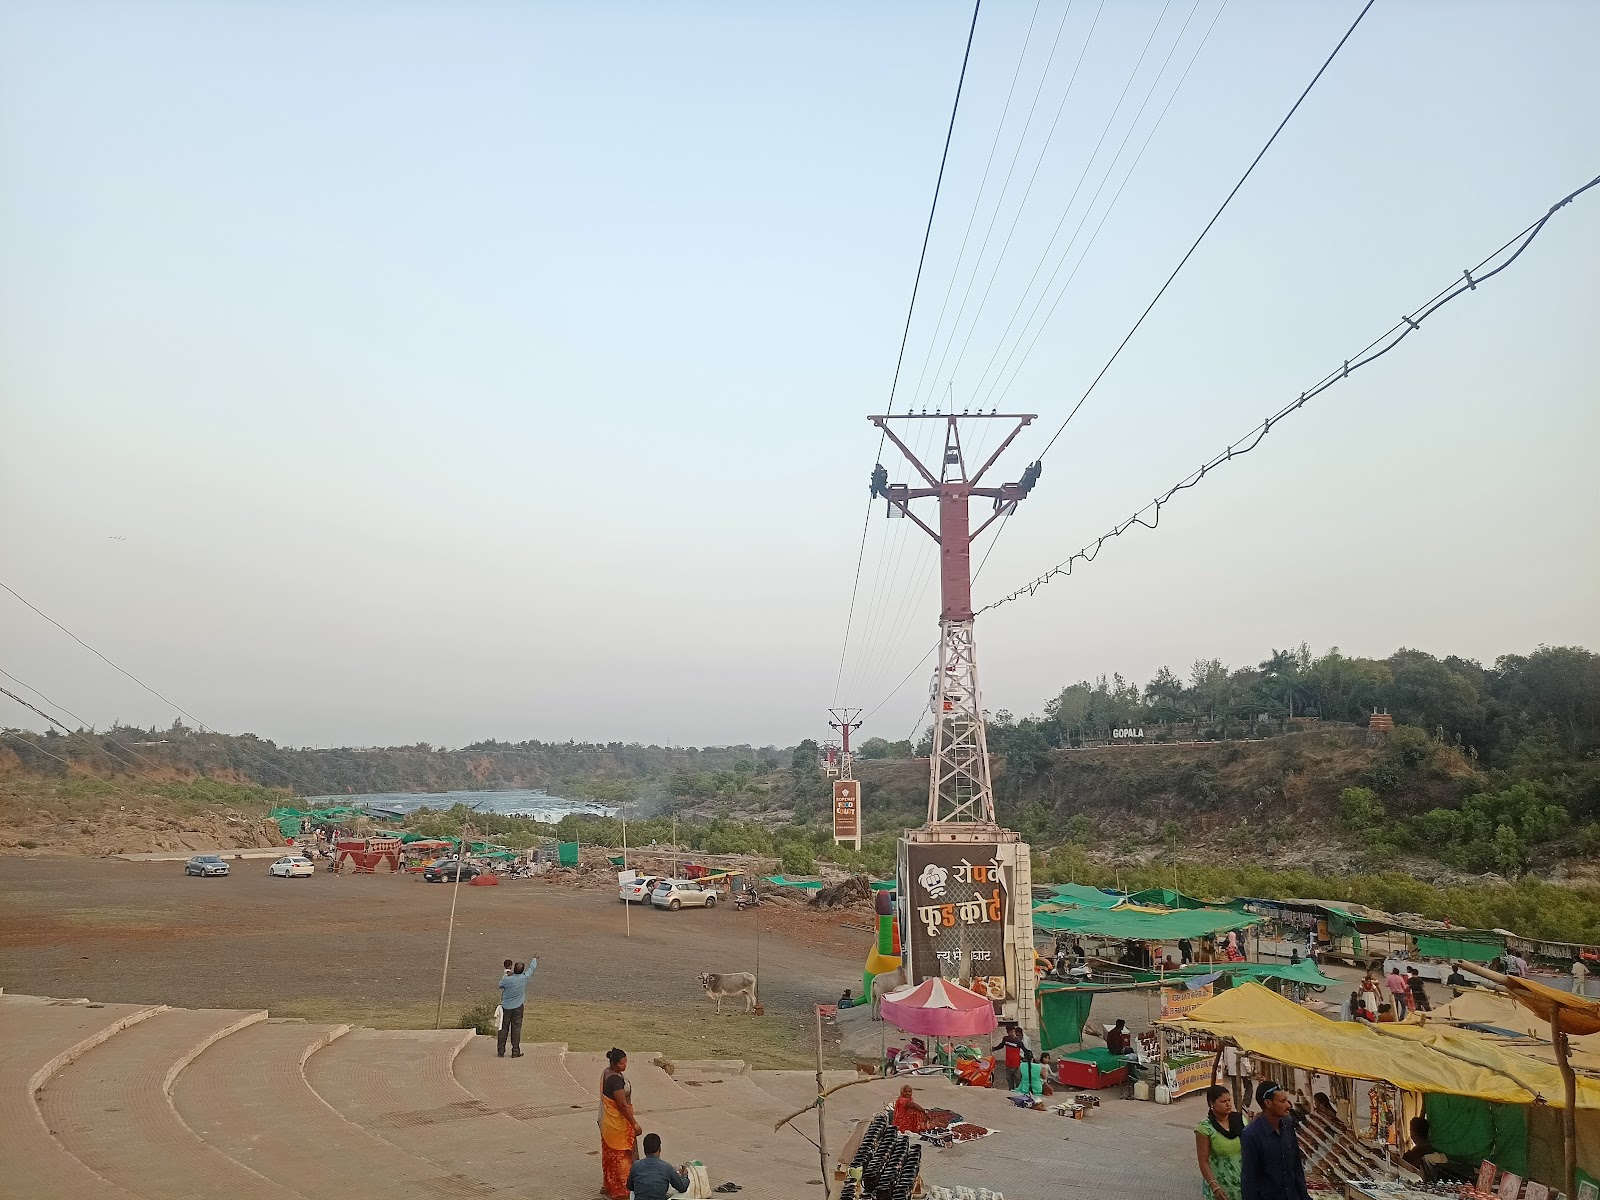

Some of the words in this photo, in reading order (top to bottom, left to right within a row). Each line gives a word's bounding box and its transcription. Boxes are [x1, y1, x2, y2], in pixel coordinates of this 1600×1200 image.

[1113, 728, 1144, 738] GOPALA
[952, 858, 1000, 883] रोपवे
[917, 903, 955, 937] फूड
[956, 888, 1001, 925] कोर्ट
[936, 950, 954, 965] न्यू
